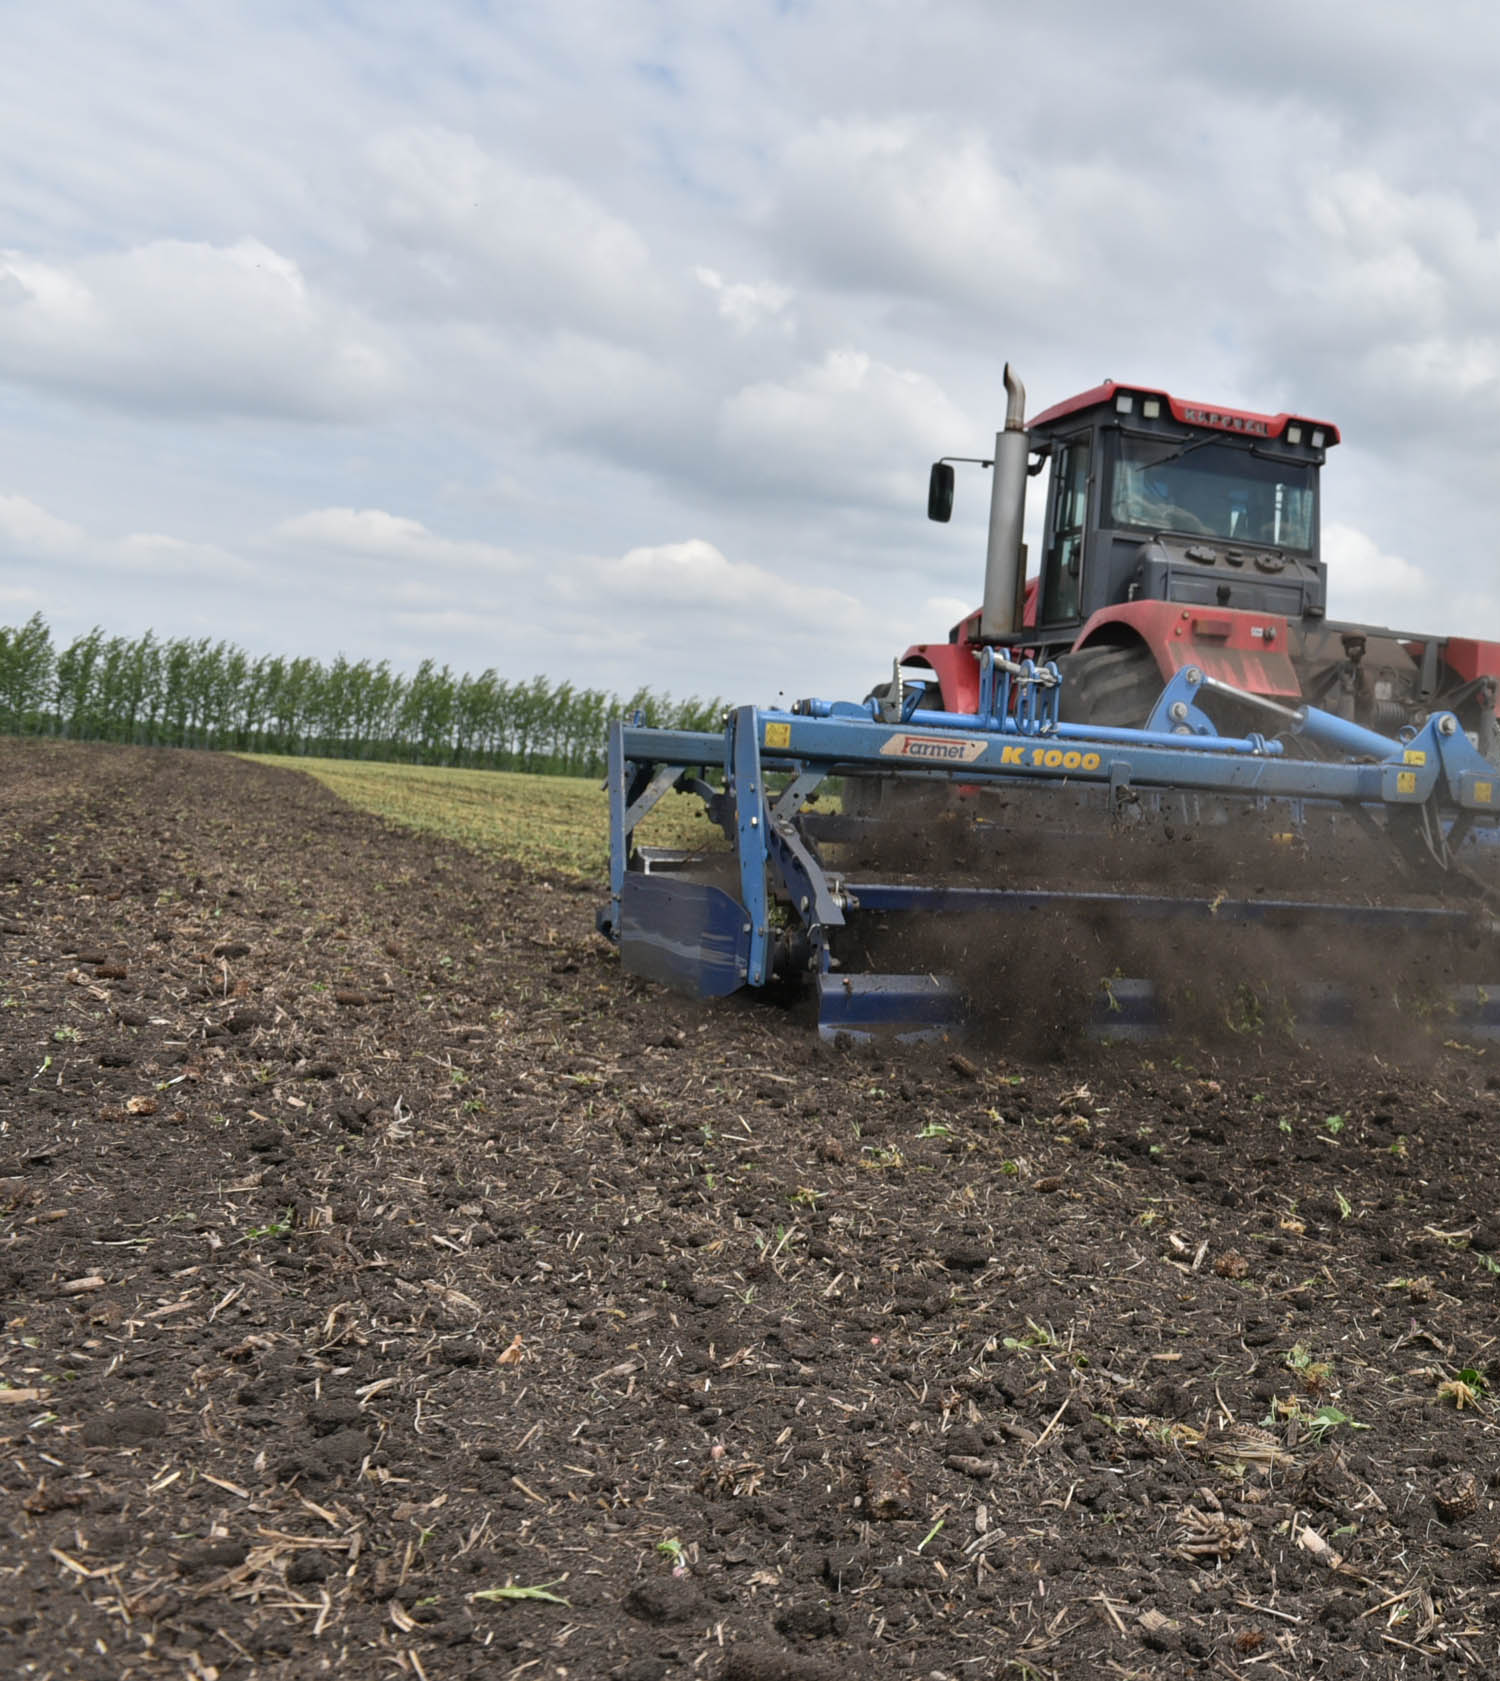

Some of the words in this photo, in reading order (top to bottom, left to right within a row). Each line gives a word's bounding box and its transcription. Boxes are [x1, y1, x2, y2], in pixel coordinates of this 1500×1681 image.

[901, 736, 967, 759] Farmet
[1001, 746, 1025, 765] K
[1032, 749, 1100, 770] 1000
